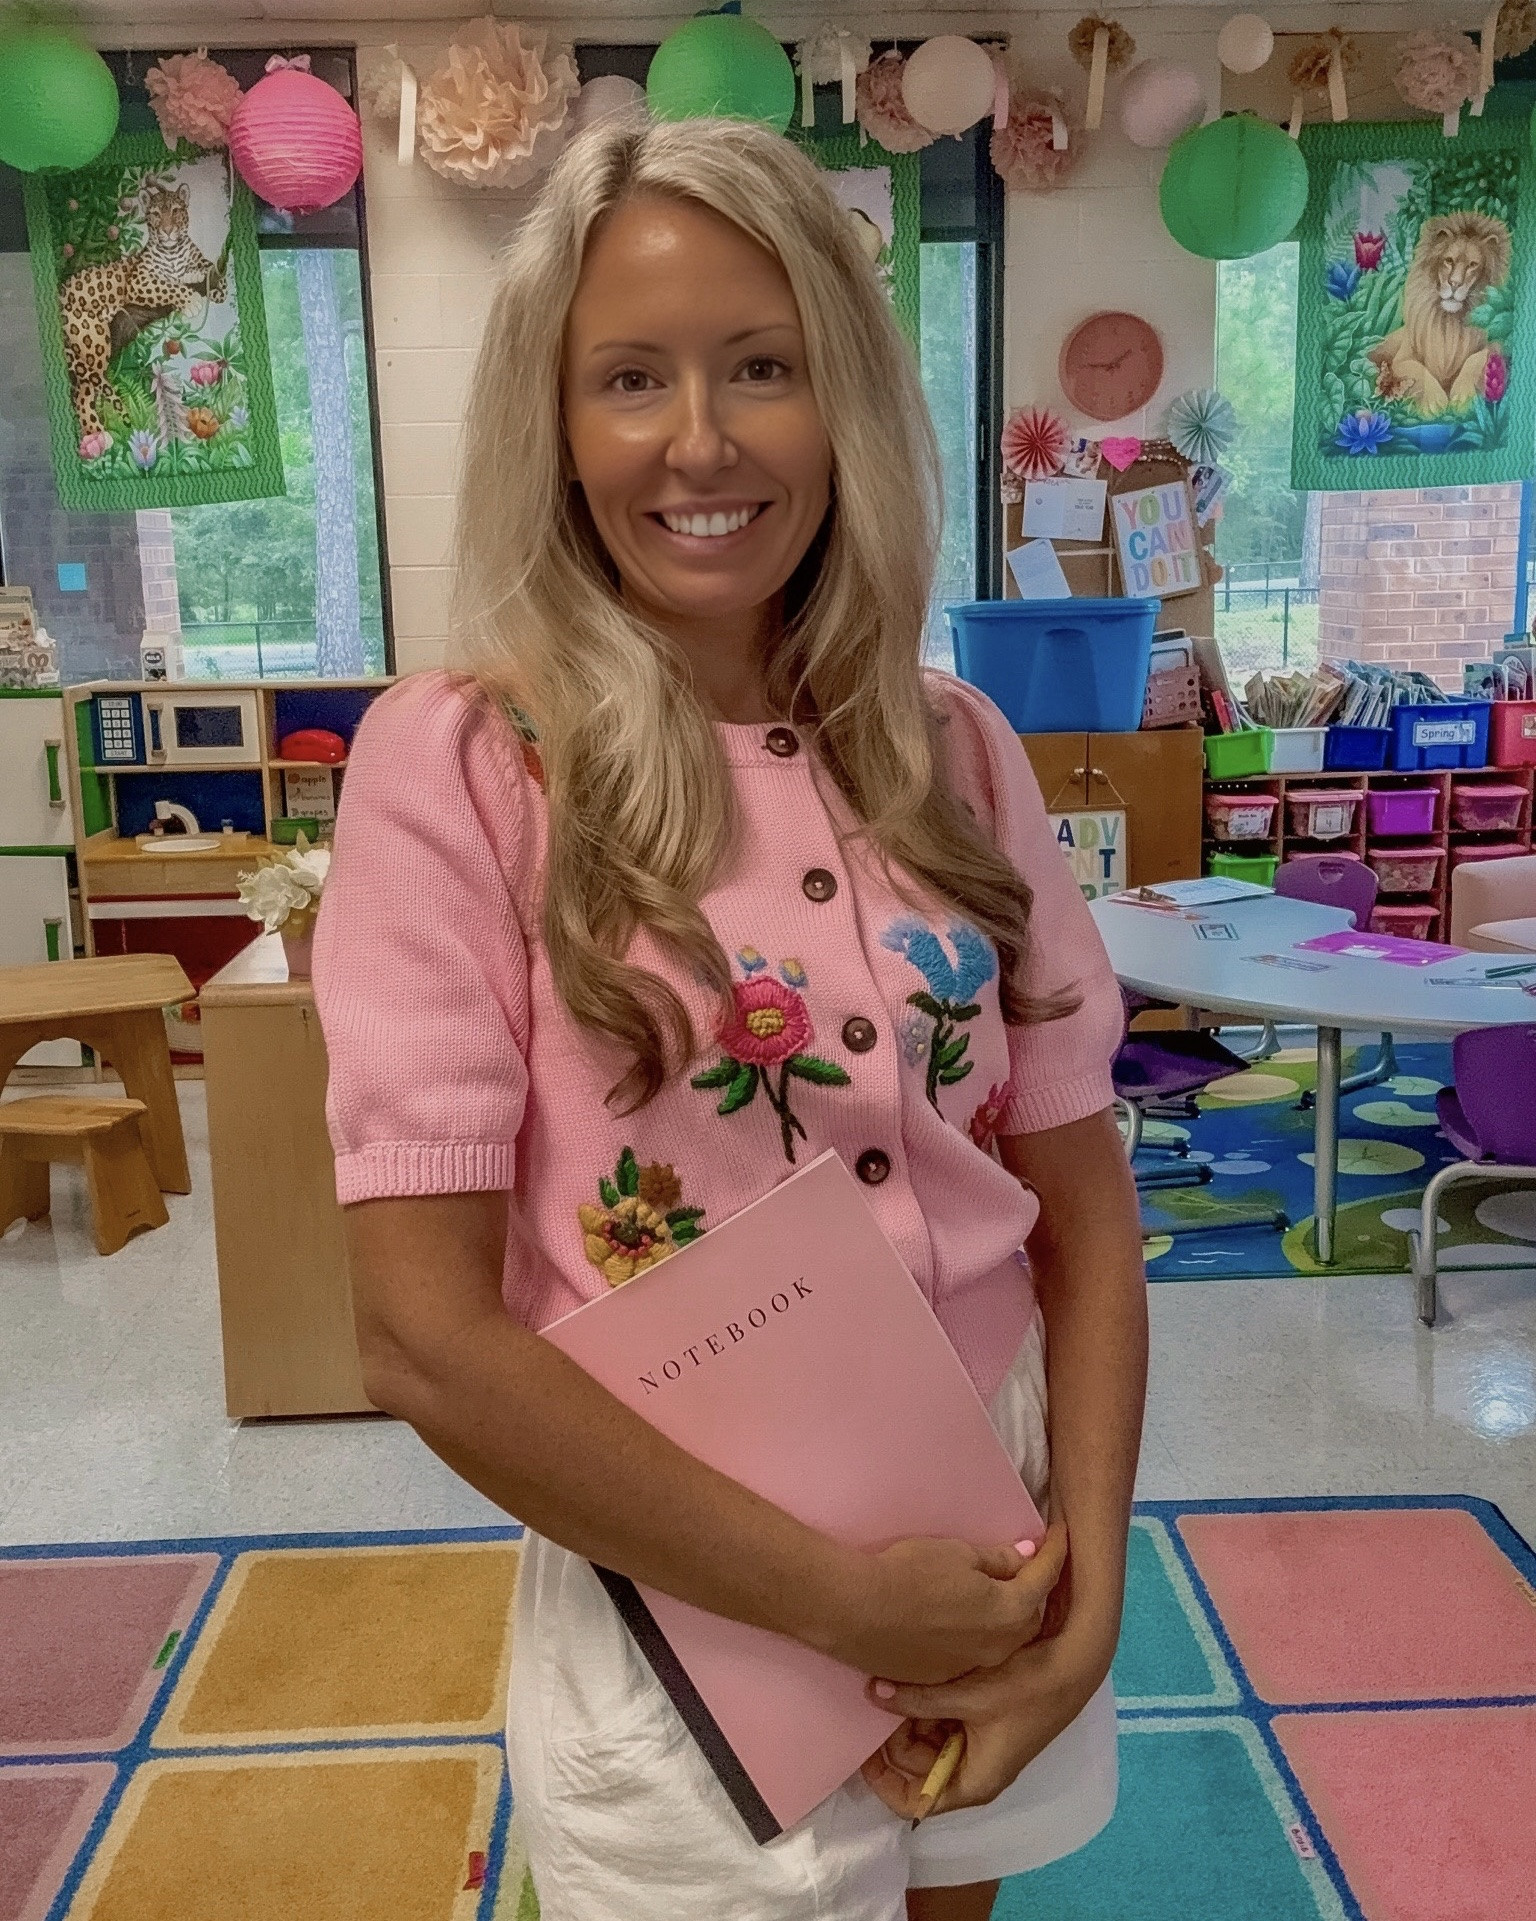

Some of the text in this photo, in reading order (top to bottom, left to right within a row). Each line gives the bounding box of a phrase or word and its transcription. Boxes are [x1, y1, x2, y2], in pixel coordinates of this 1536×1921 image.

[1121, 490, 1181, 529] YOU
[1129, 520, 1195, 561] CAN
[1131, 550, 1195, 592] DO IT
[1421, 728, 1455, 740] Spring
[1057, 816, 1120, 849] ADV
[638, 1277, 813, 1394] NOTEBOOK
